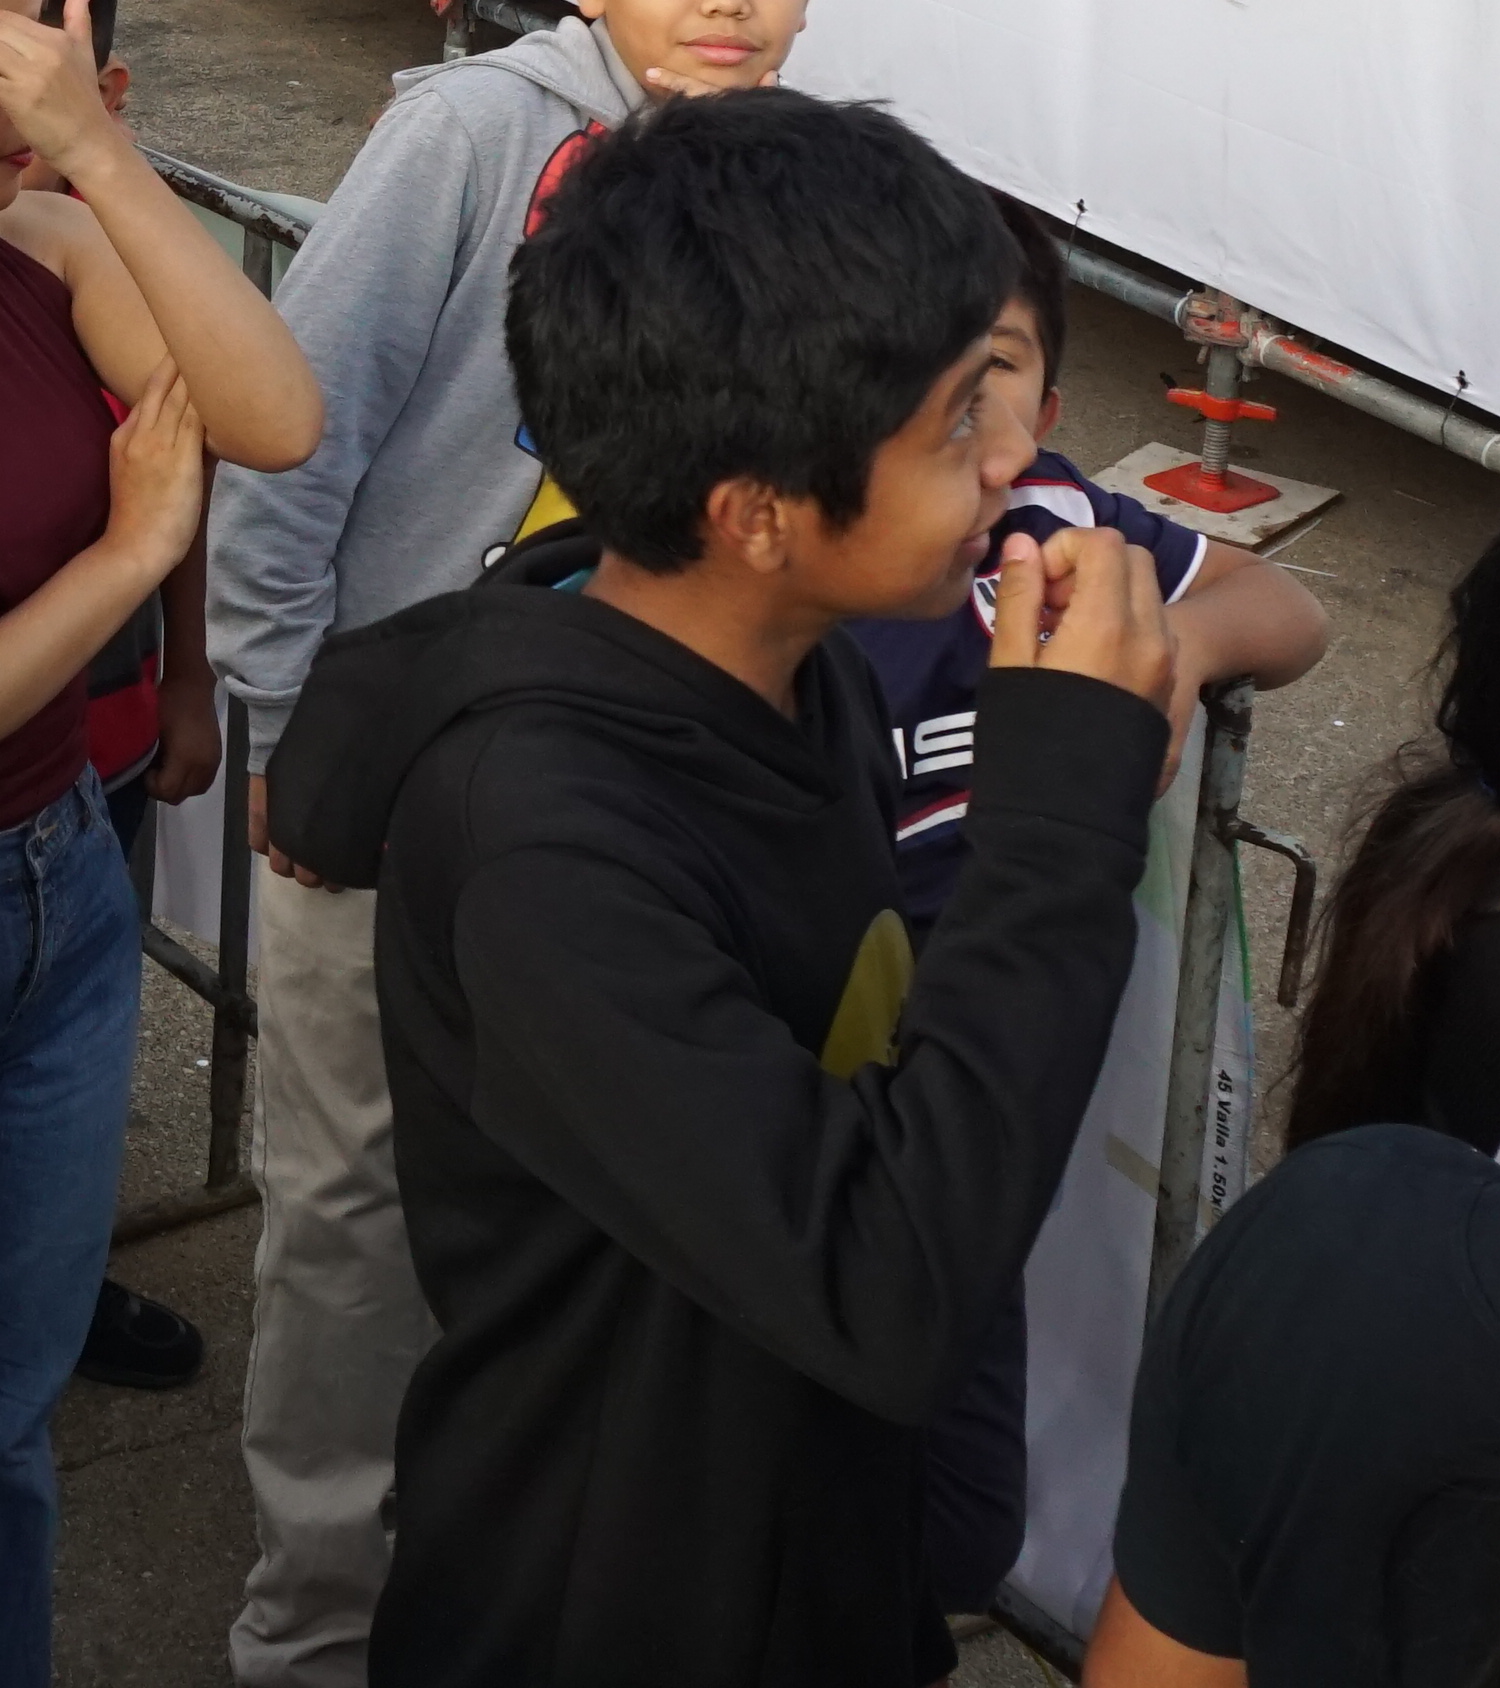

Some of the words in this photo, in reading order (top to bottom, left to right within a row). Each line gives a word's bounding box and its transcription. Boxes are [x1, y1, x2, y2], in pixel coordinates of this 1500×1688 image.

[1217, 1069, 1233, 1094] 45
[1215, 1100, 1232, 1149] Valla
[1211, 1155, 1228, 1209] 1.50x
